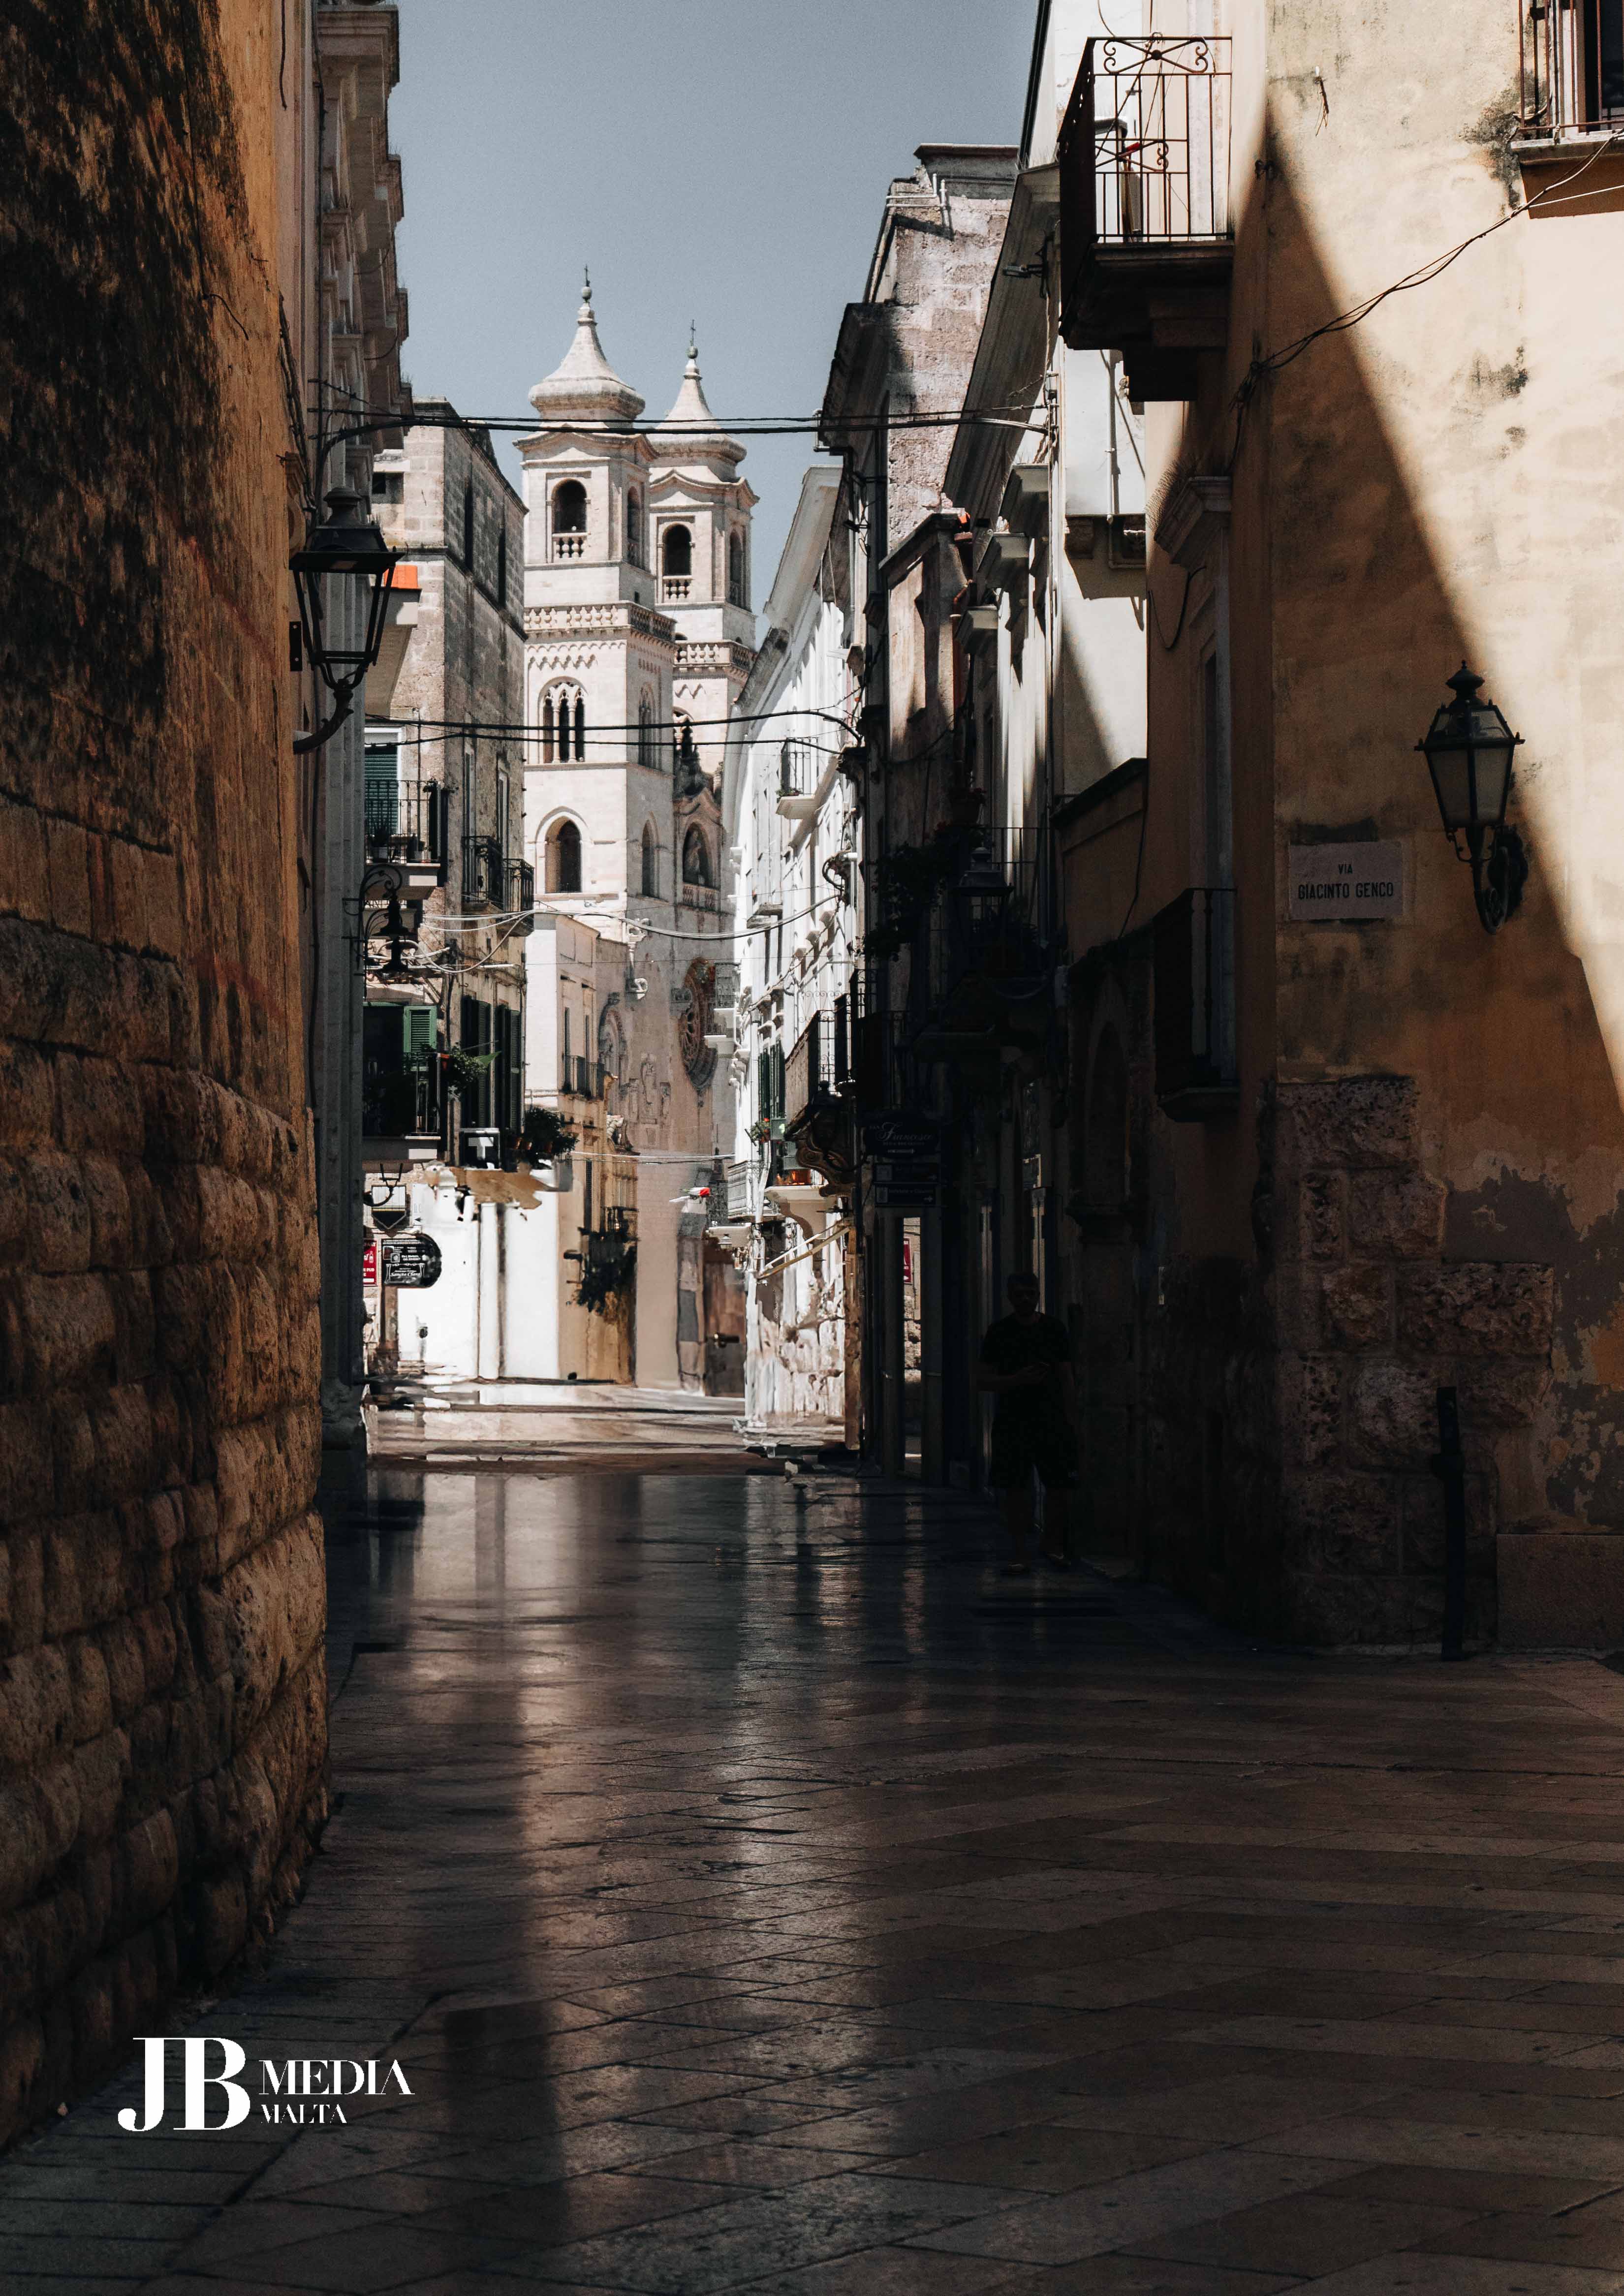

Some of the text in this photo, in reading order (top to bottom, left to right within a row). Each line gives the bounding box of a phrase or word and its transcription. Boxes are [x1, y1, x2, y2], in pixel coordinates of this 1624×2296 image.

[1338, 864, 1353, 874] VIA
[1298, 881, 1394, 900] GIACINTO GENCO
[874, 1122, 934, 1141] Francesco
